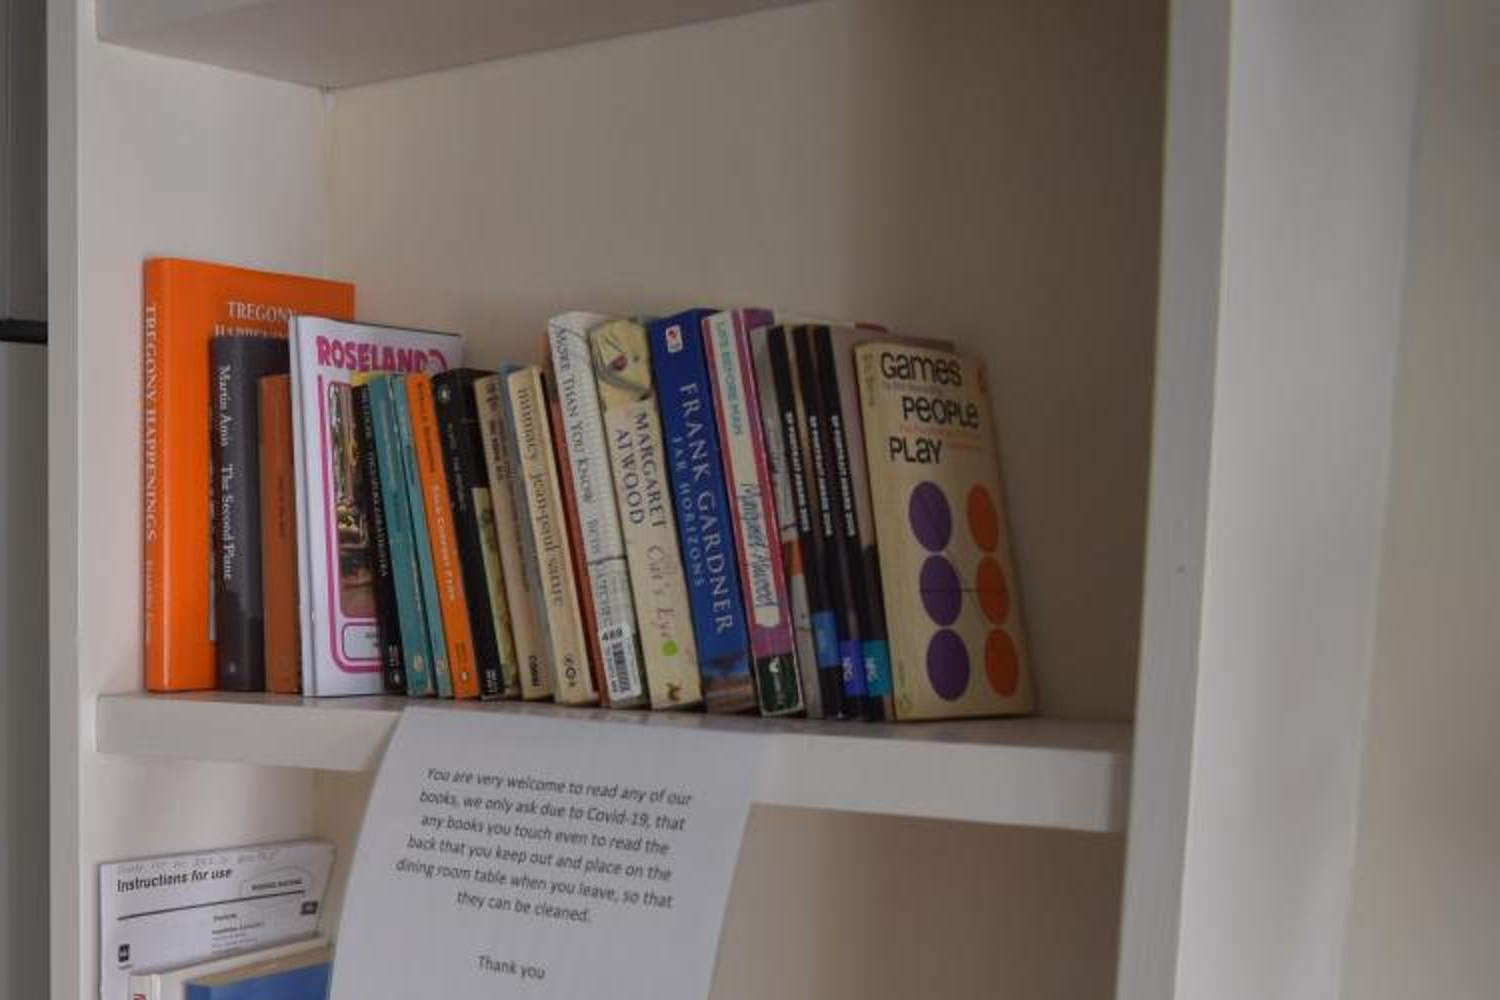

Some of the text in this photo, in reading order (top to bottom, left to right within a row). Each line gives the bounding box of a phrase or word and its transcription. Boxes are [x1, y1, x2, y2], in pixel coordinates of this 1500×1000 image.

[881, 352, 962, 387] Games
[145, 304, 157, 541] TREGONY HAPPENINGS
[219, 364, 233, 447] Martin Amis
[564, 375, 579, 418] THAN
[577, 457, 594, 502] KNOW
[615, 428, 645, 524] ATWOOD
[635, 411, 668, 528] MARGARET
[222, 464, 235, 581] The Second Plane
[679, 382, 734, 634] FRANK GARDNER
[679, 483, 706, 586] HORIZONS
[419, 790, 461, 807] books,
[463, 798, 483, 808] we
[485, 797, 514, 815] only
[515, 800, 538, 815] ask
[540, 801, 567, 817] due
[568, 805, 584, 820] to
[654, 814, 687, 831] that
[427, 768, 693, 806] You are very welcome to read any of our
[407, 833, 672, 882] back that you keep out and place on the
[420, 815, 671, 856] any books you touch even to read the
[116, 867, 233, 893] Instructions for use
[395, 858, 673, 910] dining room table when you leave, so that
[457, 890, 485, 911] they
[486, 896, 512, 911] can
[513, 898, 532, 914] be
[477, 954, 546, 980] Thank you
